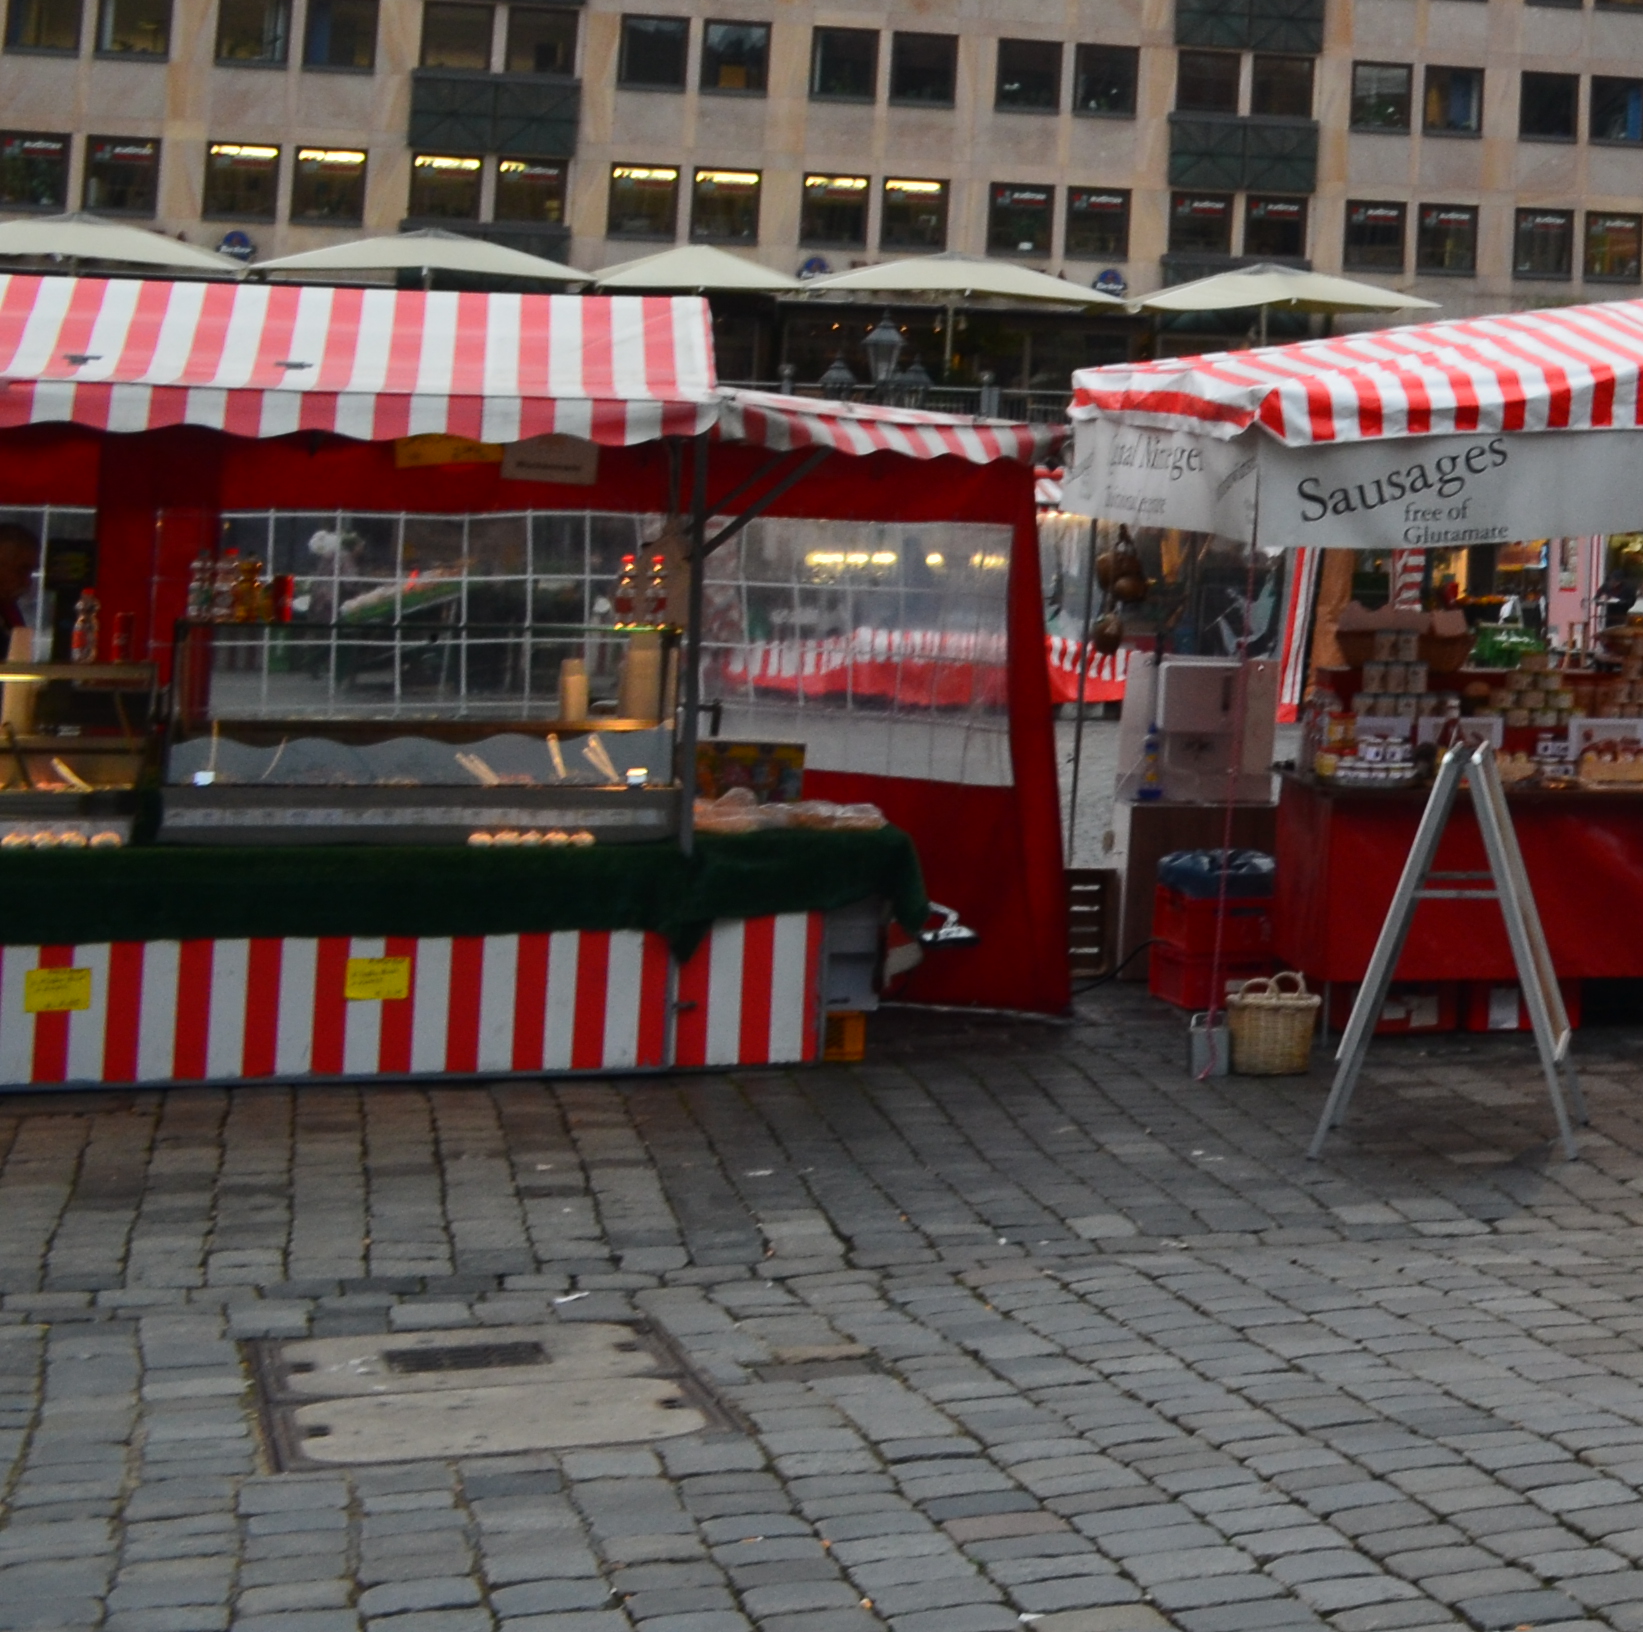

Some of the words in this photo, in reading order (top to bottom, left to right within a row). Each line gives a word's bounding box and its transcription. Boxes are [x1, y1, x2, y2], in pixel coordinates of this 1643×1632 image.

[1297, 437, 1508, 523] Sausages
[1403, 501, 1443, 523] free
[1447, 497, 1473, 521] of
[1403, 523, 1510, 545] Glutamate
